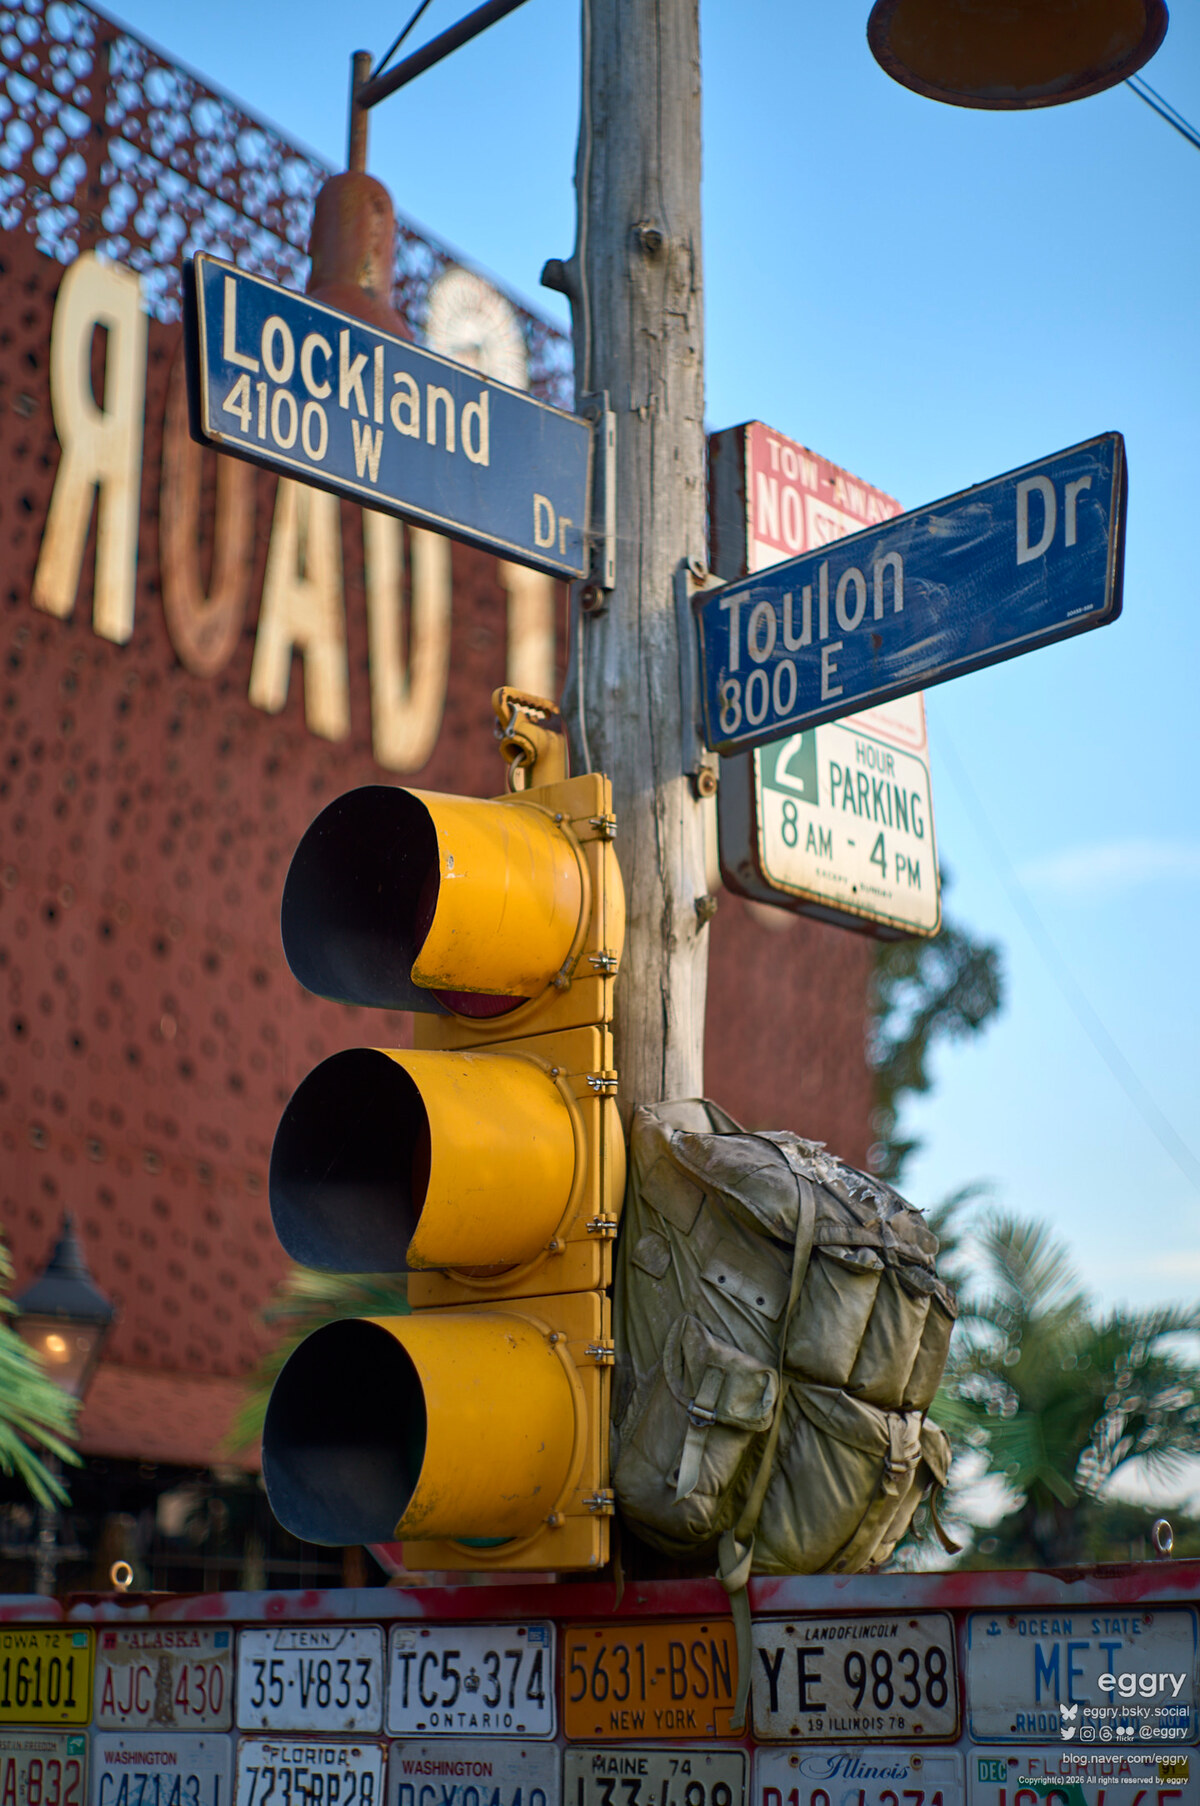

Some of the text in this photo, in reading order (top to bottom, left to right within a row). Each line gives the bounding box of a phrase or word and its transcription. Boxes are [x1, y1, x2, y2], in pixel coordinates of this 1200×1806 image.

[223, 276, 490, 467] Lockland
[222, 374, 384, 483] 4100 W
[533, 493, 573, 555] Dr
[756, 471, 803, 551] NO
[1016, 473, 1092, 566] Dr
[719, 550, 904, 673] Toulon
[718, 641, 844, 735] 800 E
[774, 733, 895, 793] 2 HOUR
[829, 760, 924, 840] PARKING
[781, 799, 798, 848] 8
[805, 821, 833, 861] AM
[870, 831, 887, 879] 4
[895, 852, 921, 892] PM
[128, 1631, 201, 1648] ALASKA
[290, 1632, 331, 1645] TENN
[1018, 1618, 1142, 1636] OCEAN STATE
[100, 1664, 223, 1715] AJC 430
[758, 1646, 948, 1713] YE 9838
[1035, 1642, 1122, 1706] MET
[429, 1712, 512, 1728] ONTARIO
[610, 1709, 697, 1730] NEW YORK
[808, 1716, 906, 1732] 19 ILLINOIS 78
[104, 1751, 177, 1766] WASHINGTON
[269, 1747, 350, 1765] FLORIDA
[402, 1760, 493, 1777] WASHINGTON
[592, 1757, 692, 1777] MAINE 74
[800, 1753, 911, 1780] Illinois
[979, 1761, 1007, 1782] DEC
[1028, 1758, 1132, 1776] FLORIDA
